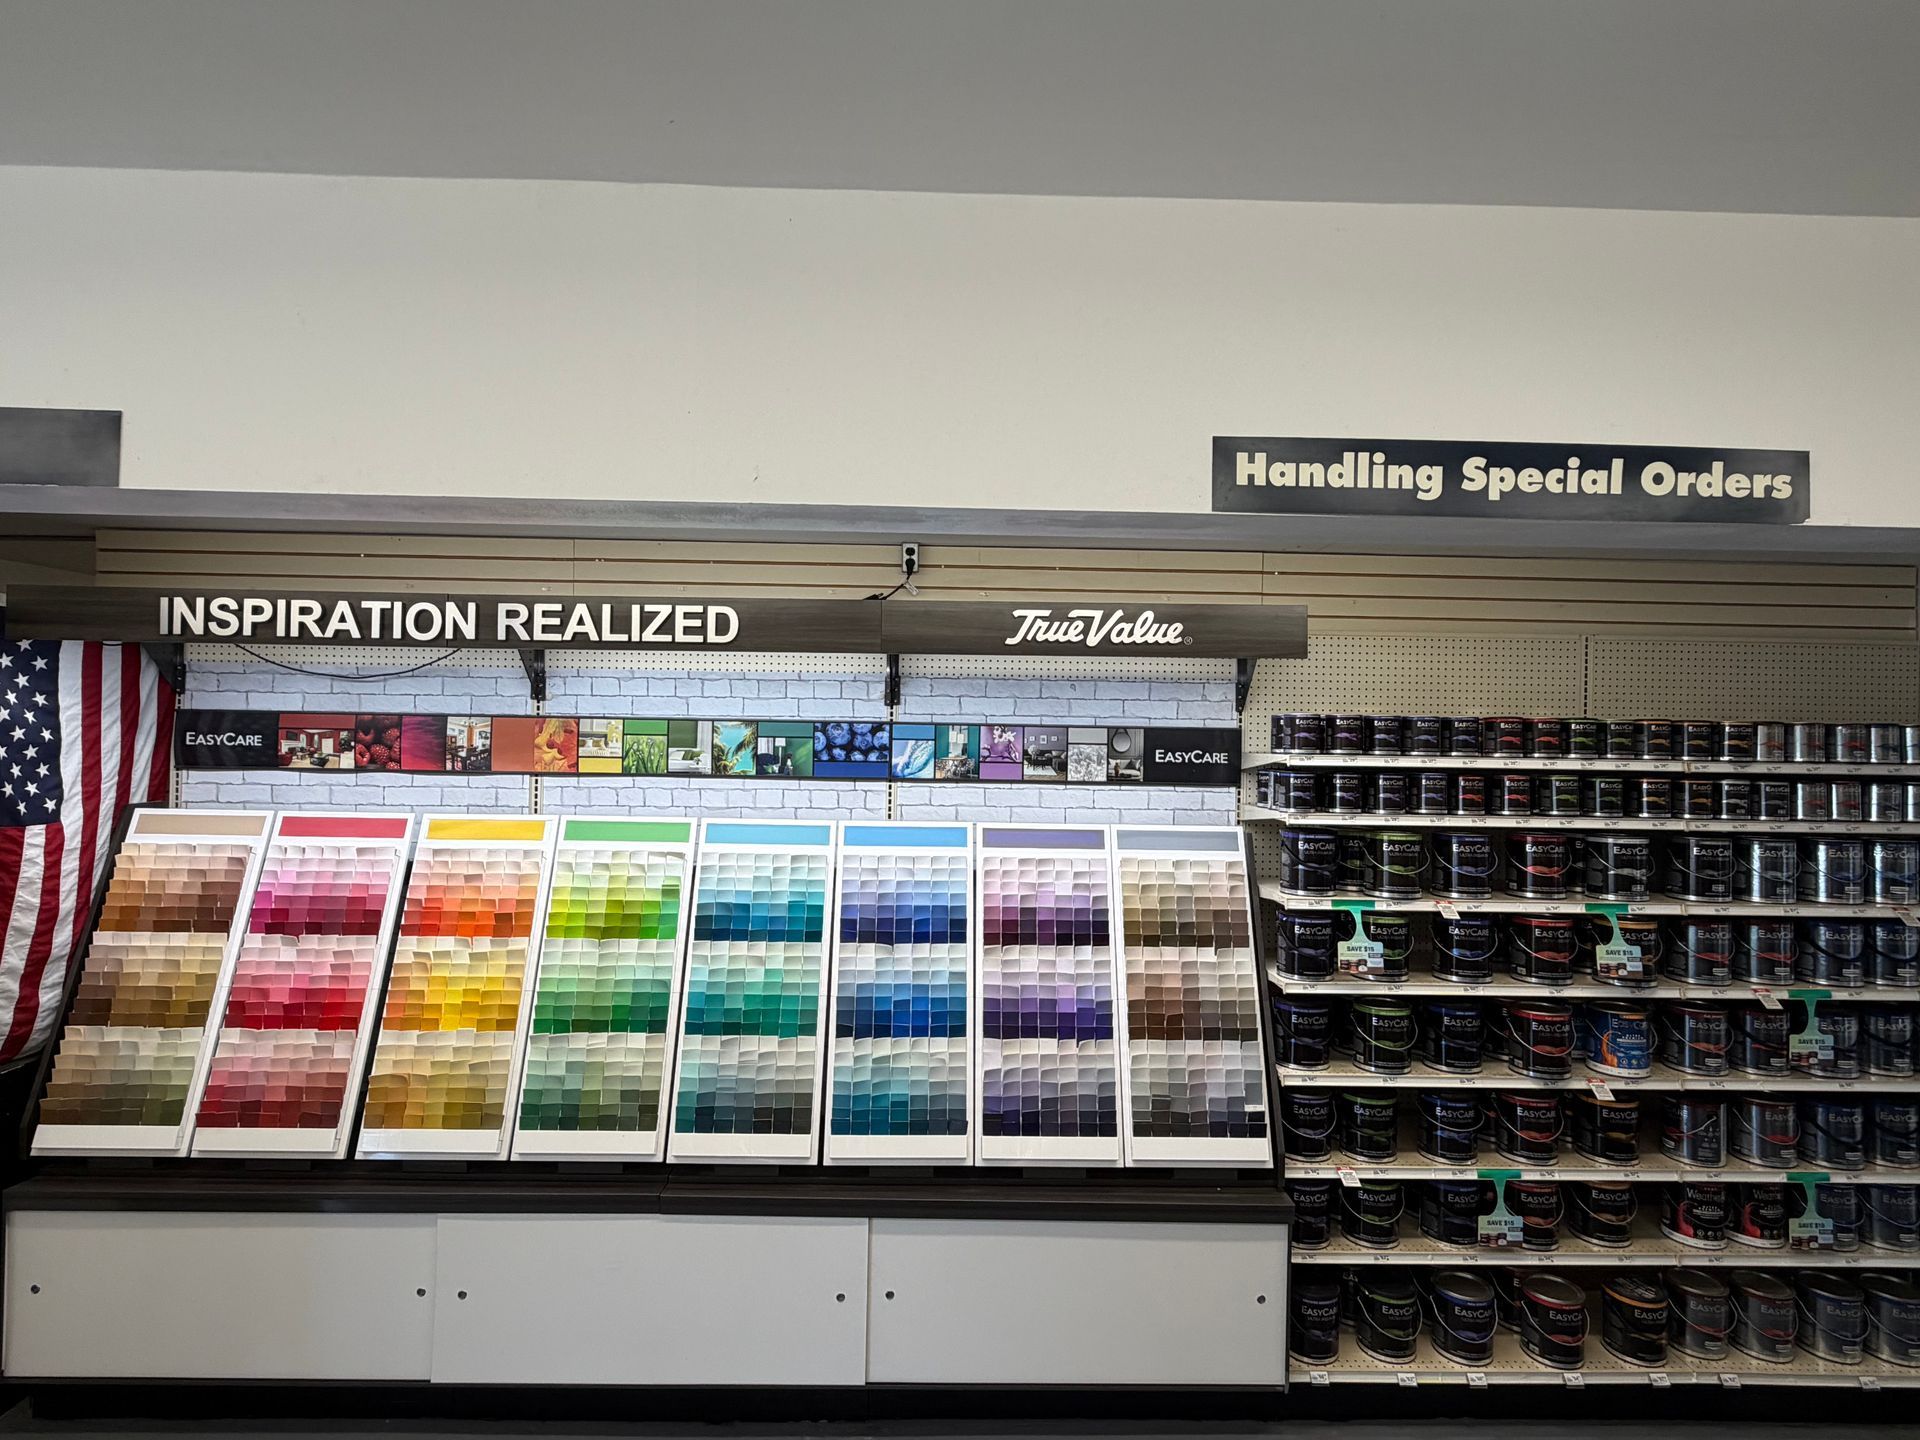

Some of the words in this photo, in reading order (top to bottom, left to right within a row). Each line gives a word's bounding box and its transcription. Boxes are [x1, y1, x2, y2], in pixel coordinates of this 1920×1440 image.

[1236, 452, 1443, 500] Handling
[1461, 457, 1623, 500] Special
[1641, 462, 1792, 499] Orders
[160, 597, 476, 640] INSPIRATION
[498, 603, 739, 644] REALIZED
